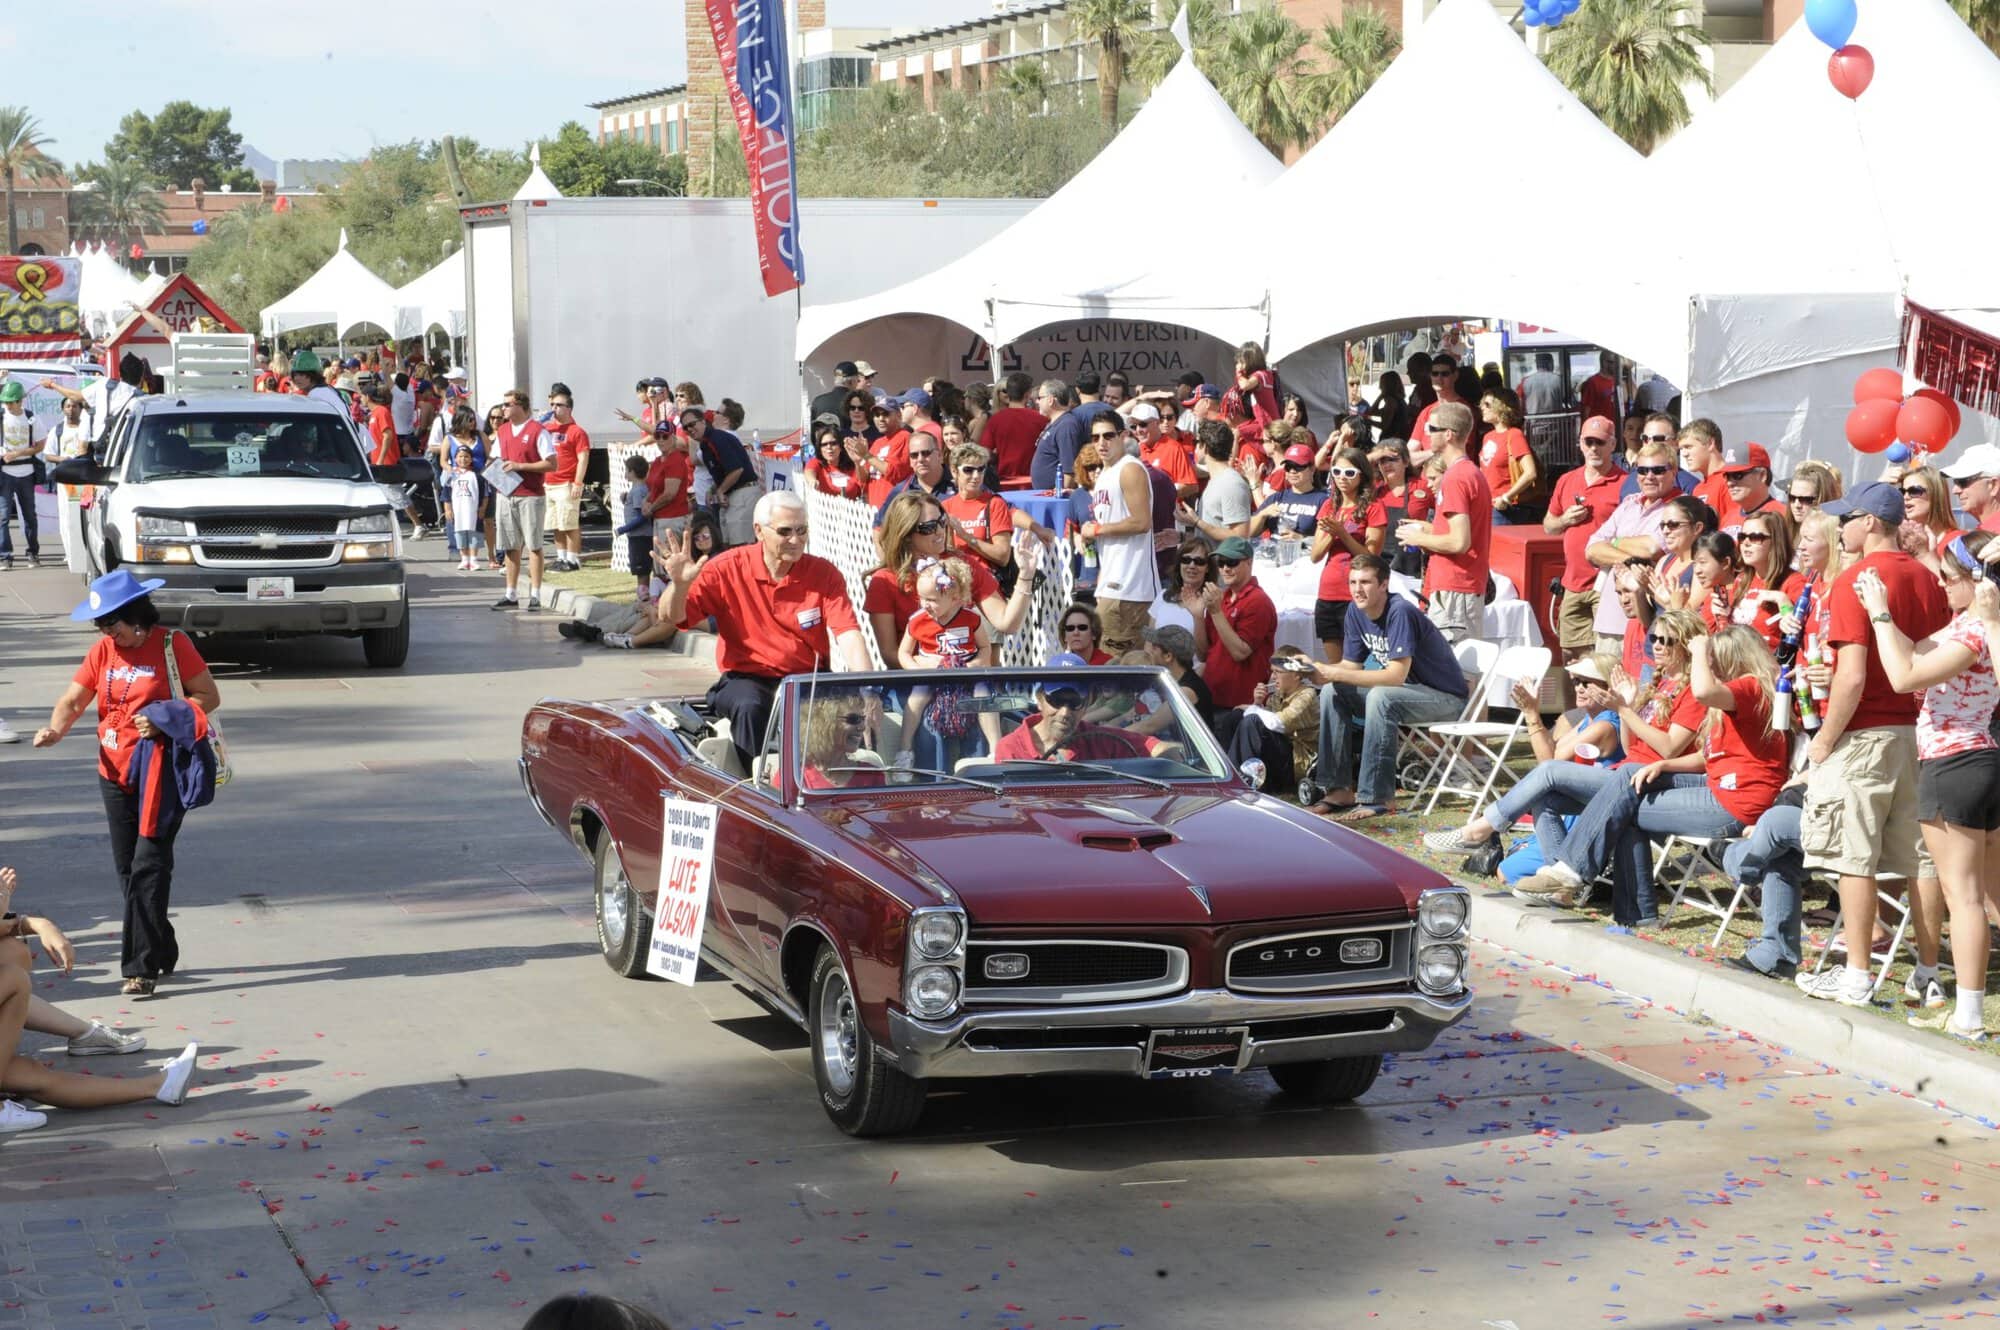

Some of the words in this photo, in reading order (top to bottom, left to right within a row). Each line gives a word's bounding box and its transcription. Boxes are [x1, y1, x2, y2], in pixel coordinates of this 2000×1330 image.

[162, 299, 197, 316] CAT
[1042, 351, 1073, 372] OF
[1078, 347, 1184, 372] ARIZONA
[231, 451, 257, 465] 35
[668, 808, 683, 826] 2009
[683, 810, 692, 827] UA
[692, 811, 711, 830] Sports
[671, 829, 683, 847] Hall
[682, 832, 690, 848] of
[689, 832, 704, 851] Fame
[669, 855, 701, 895] LUTE
[658, 895, 701, 939] OLSON
[1259, 946, 1322, 961] GTO
[1172, 1069, 1212, 1078] GTO
